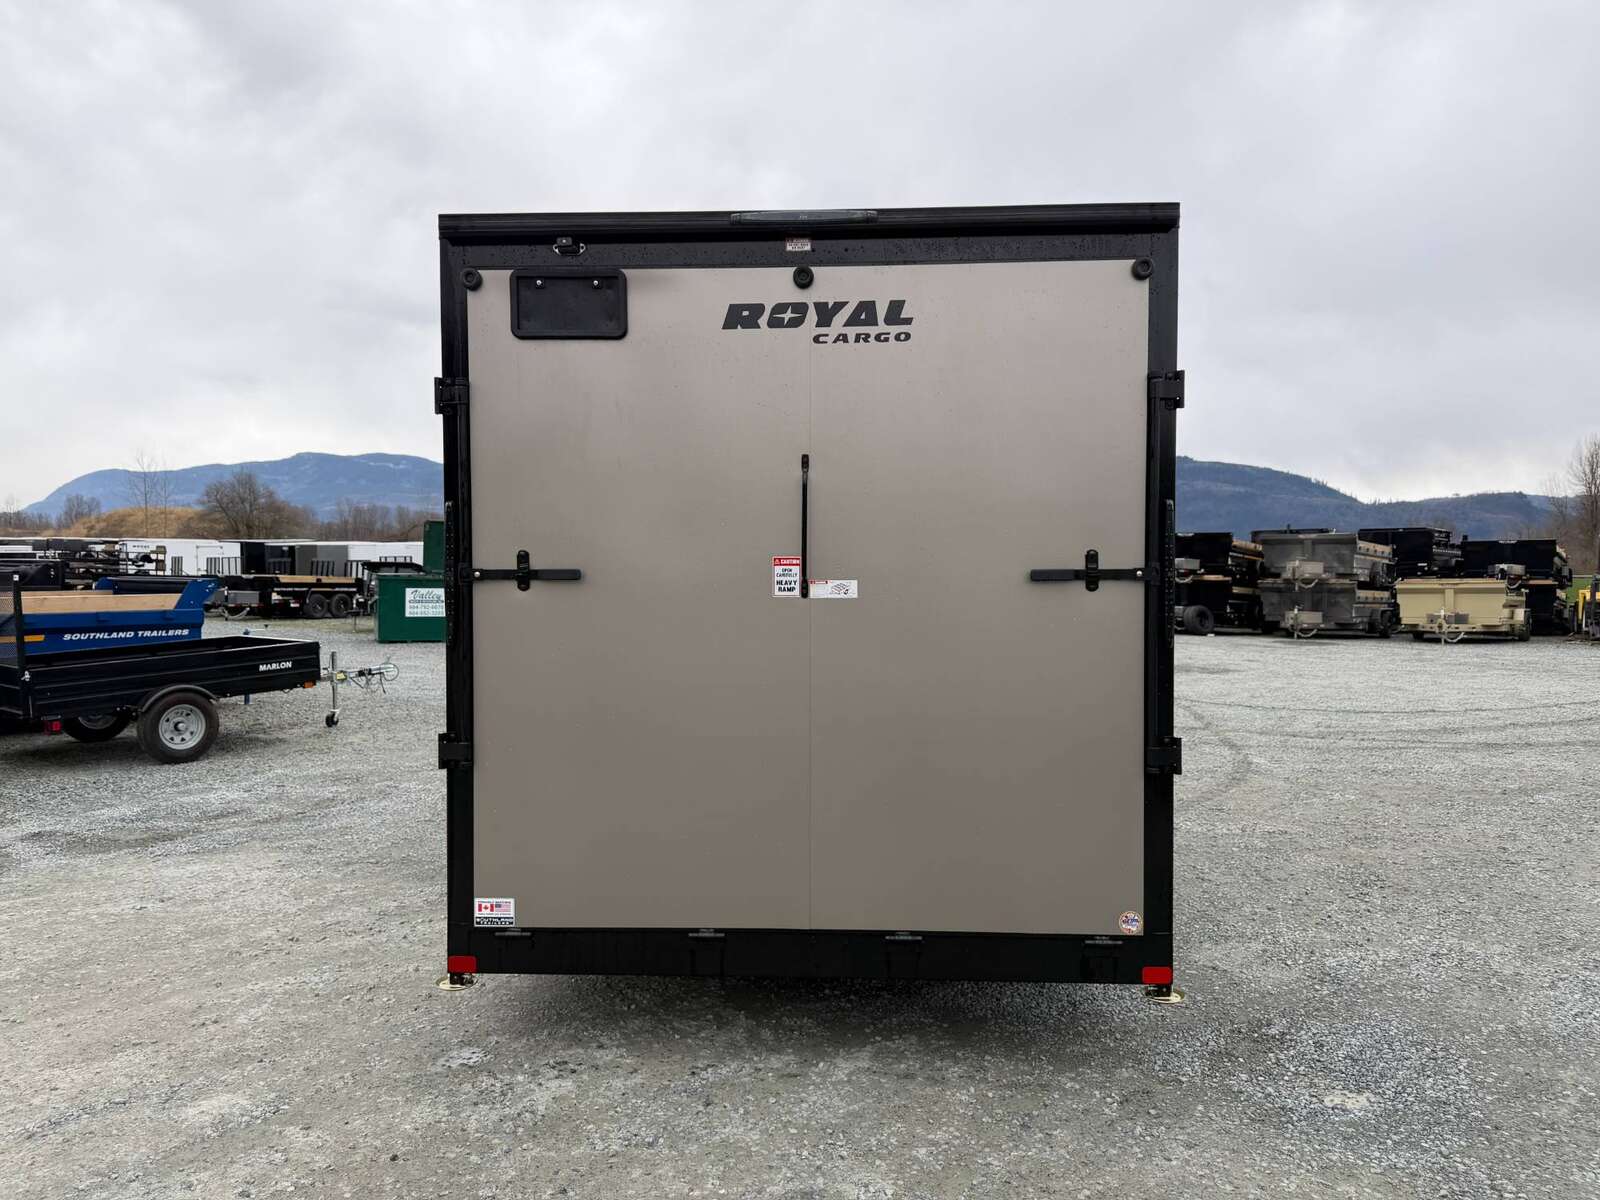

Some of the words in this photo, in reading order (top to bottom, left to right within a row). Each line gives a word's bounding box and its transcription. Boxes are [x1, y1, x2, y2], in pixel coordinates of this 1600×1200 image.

[721, 300, 914, 329] ROYAL
[812, 332, 912, 344] CARGO
[411, 590, 442, 601] Valley
[63, 631, 135, 641] SOUTHLAND
[137, 629, 190, 638] TRAILERS
[258, 661, 292, 672] MARLON
